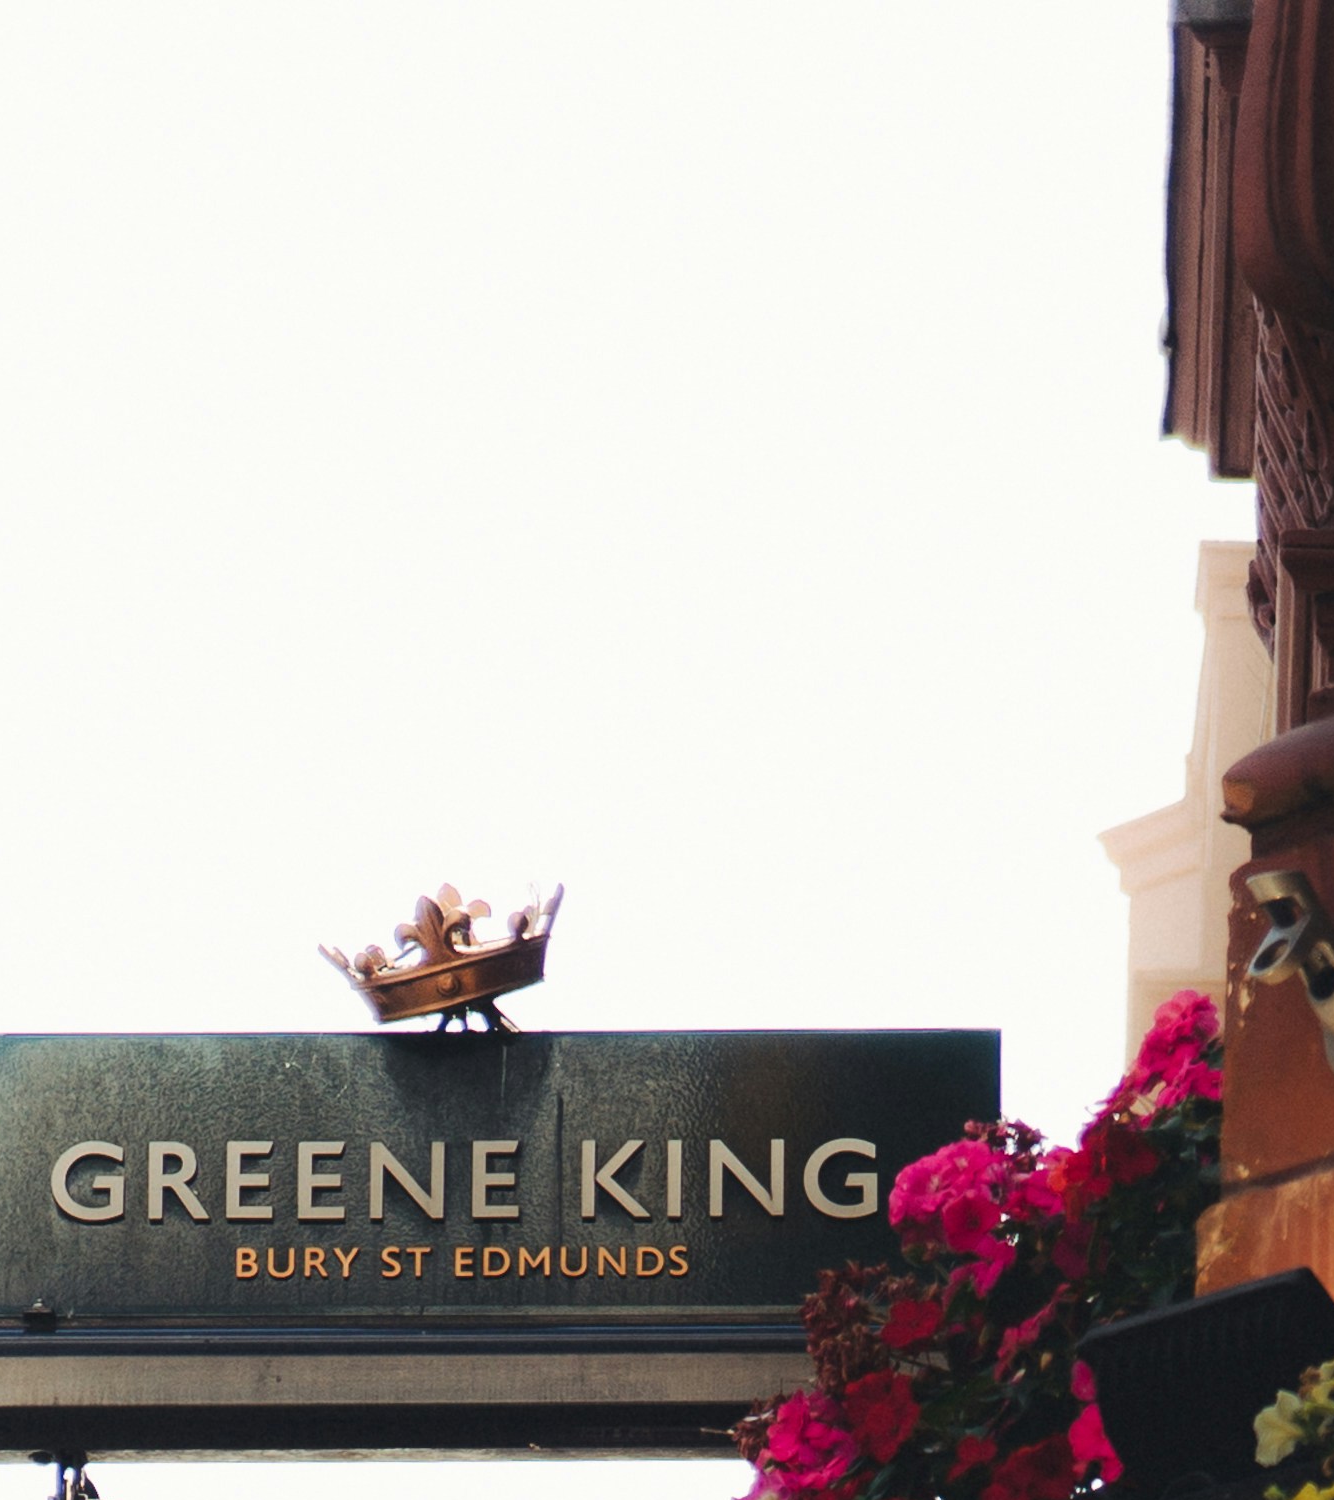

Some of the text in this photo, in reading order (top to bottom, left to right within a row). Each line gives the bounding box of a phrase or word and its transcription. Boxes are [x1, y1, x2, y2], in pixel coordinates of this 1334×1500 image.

[51, 1138, 878, 1222] GREENE KING
[236, 1245, 689, 1279] BURY ST EDMUNDS
